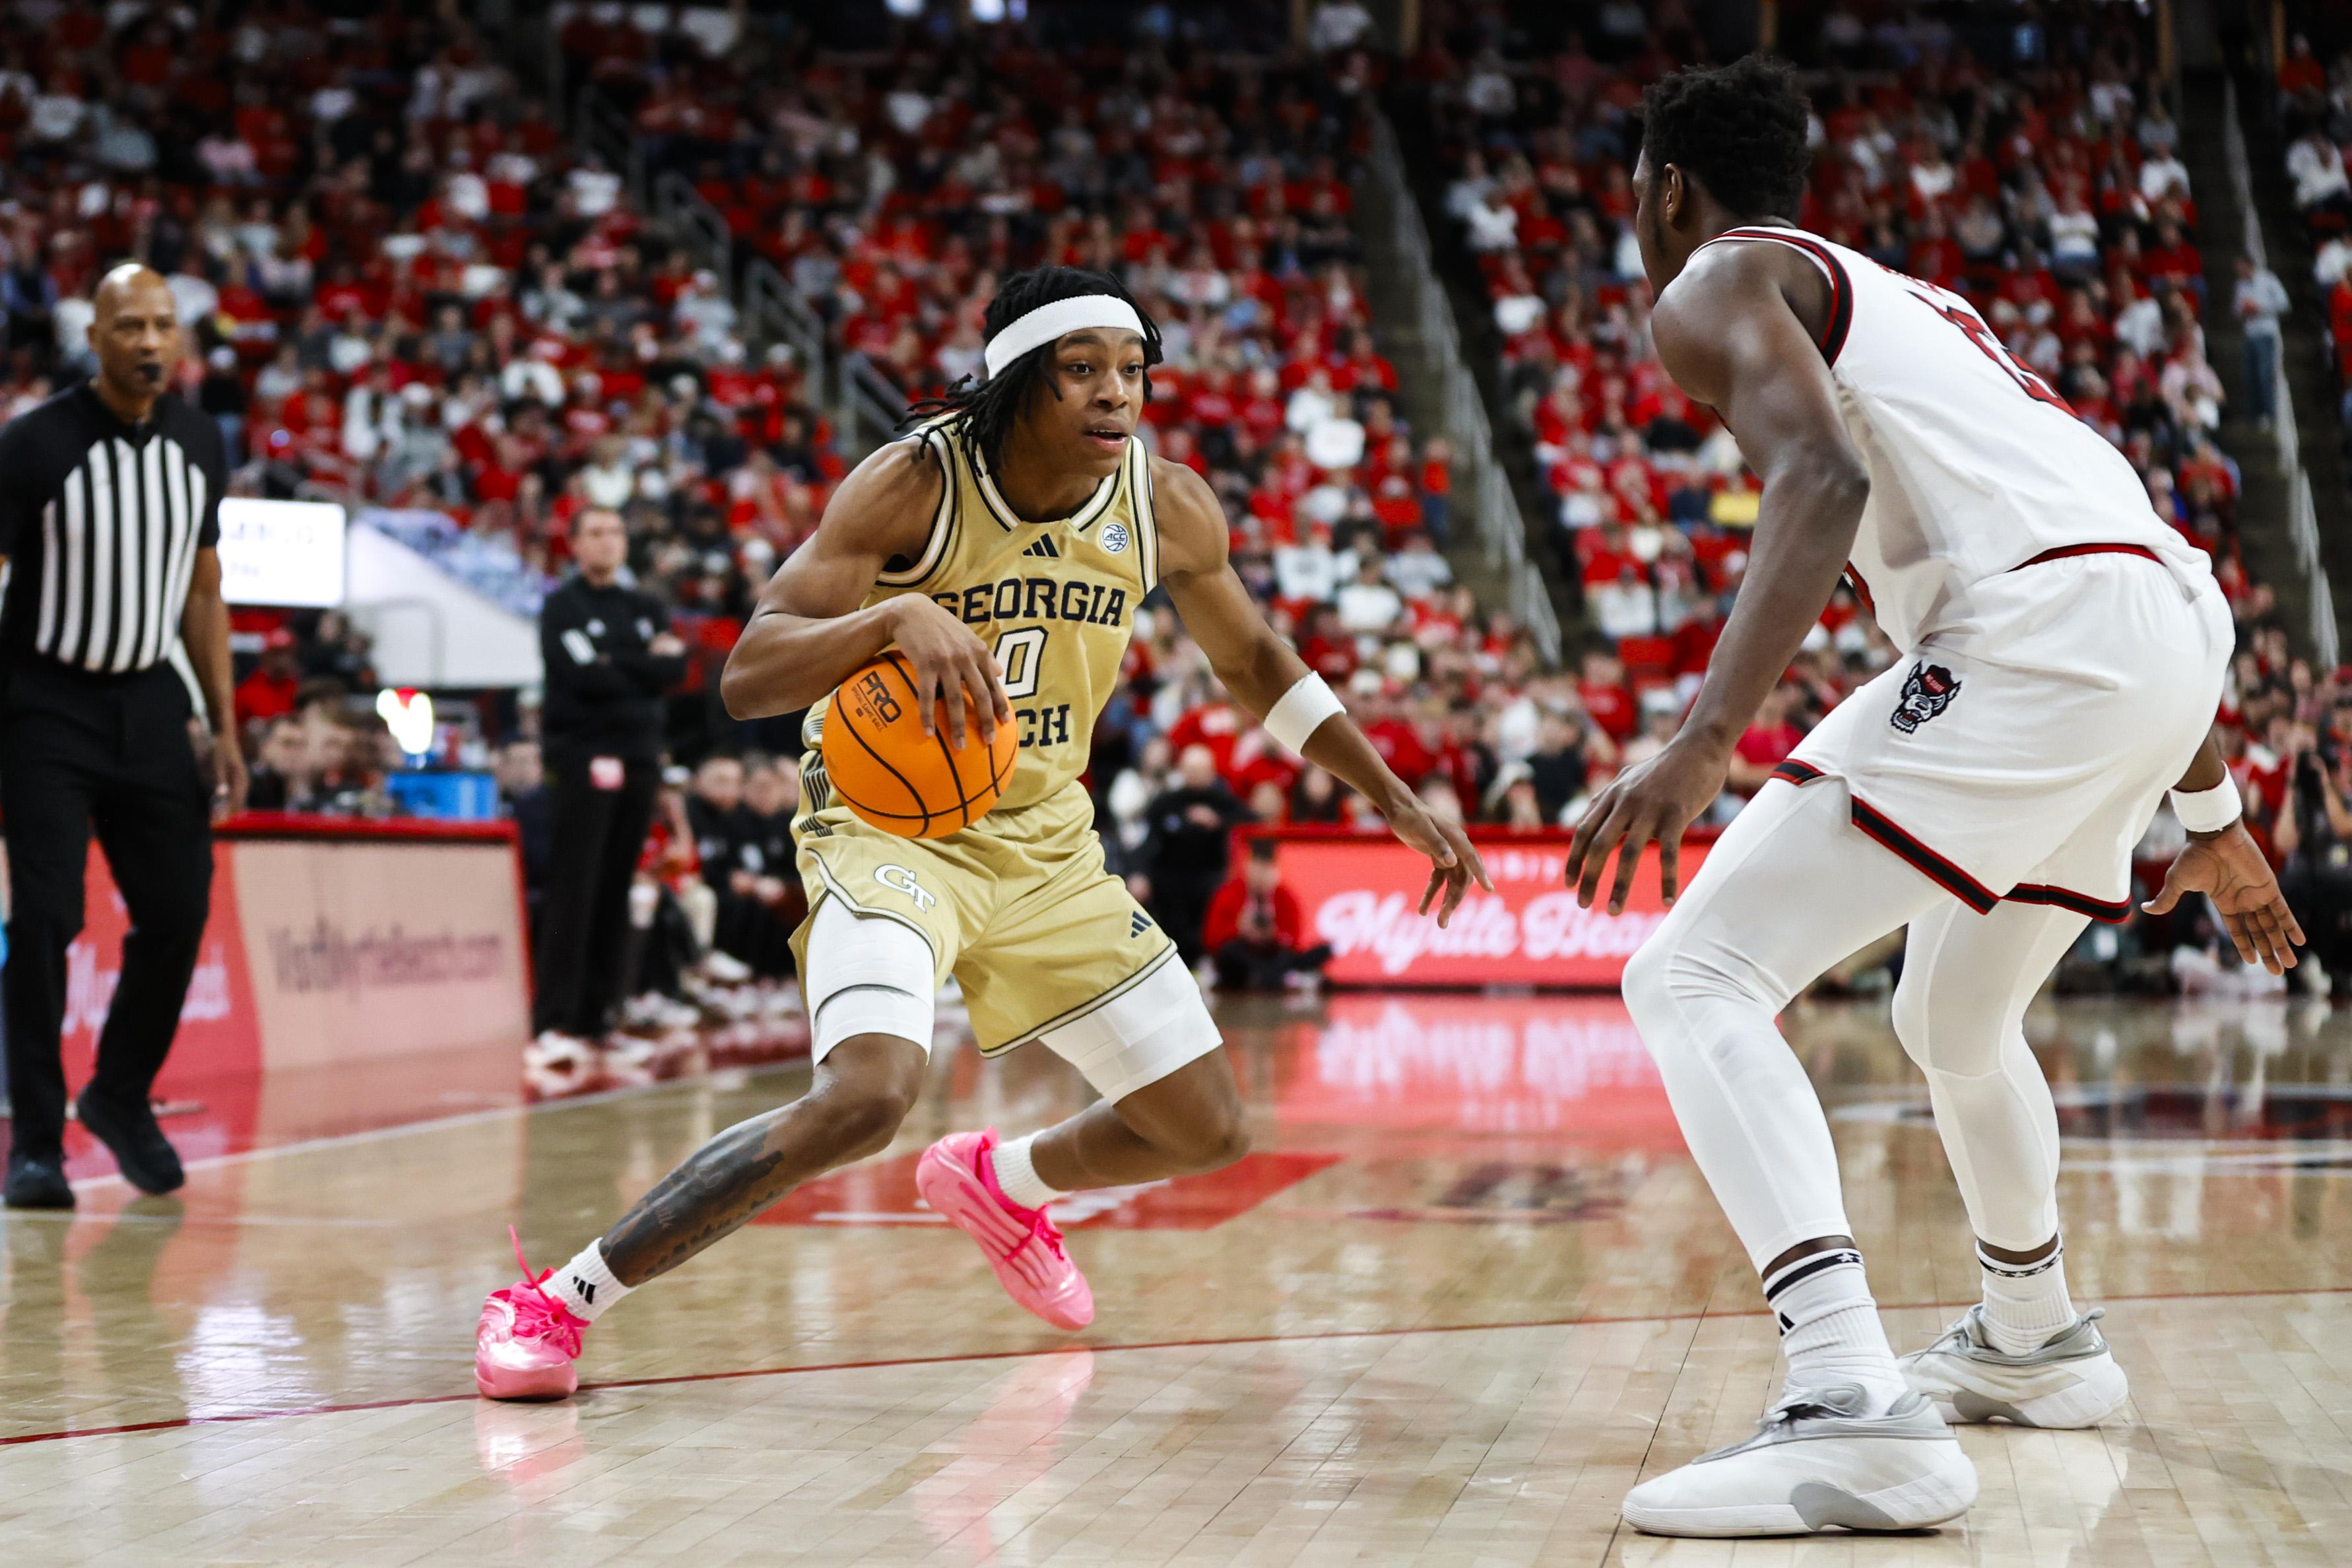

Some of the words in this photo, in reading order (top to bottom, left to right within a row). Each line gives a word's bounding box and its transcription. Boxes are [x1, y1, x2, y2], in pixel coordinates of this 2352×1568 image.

[931, 578, 1126, 626] GEORGIA
[994, 625, 1049, 699] 0
[861, 670, 901, 723] PRO
[1016, 703, 1070, 748] CH
[1522, 891, 1668, 961] Bea
